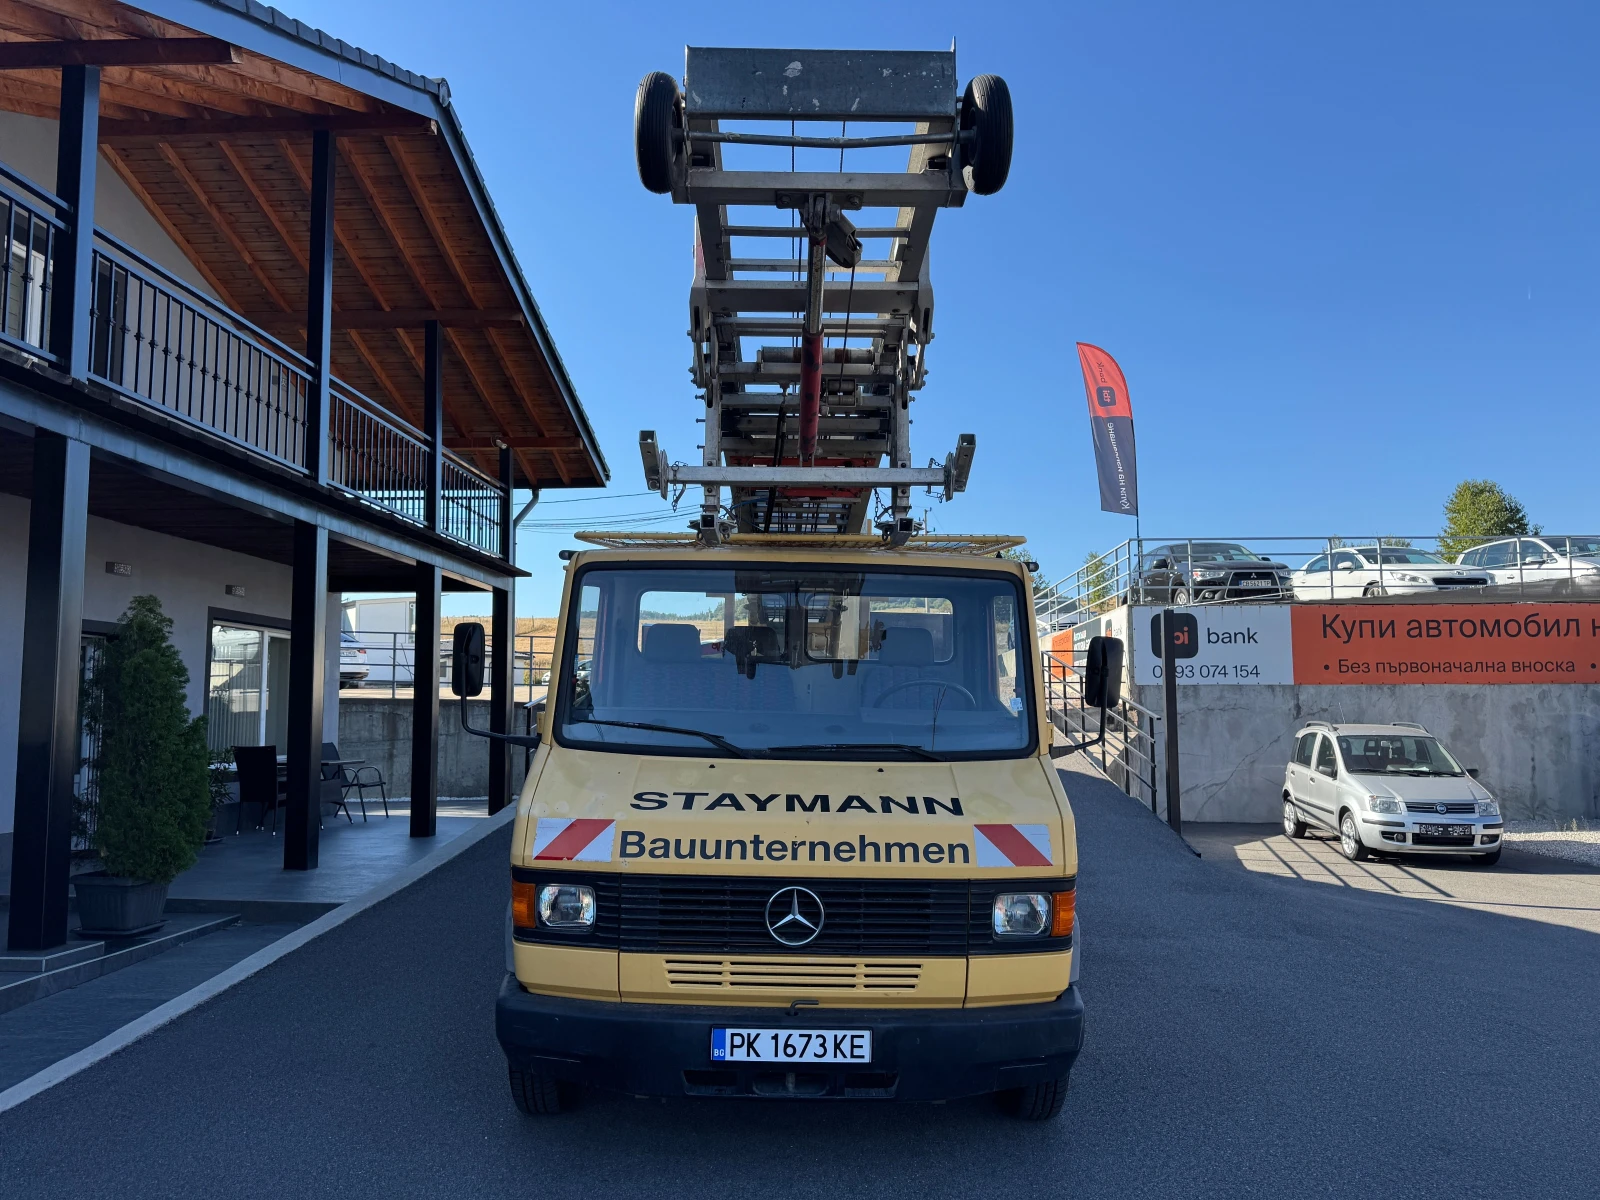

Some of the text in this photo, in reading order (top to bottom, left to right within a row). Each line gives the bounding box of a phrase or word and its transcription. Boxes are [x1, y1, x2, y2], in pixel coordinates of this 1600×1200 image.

[1207, 627, 1259, 645] bank
[1322, 613, 1396, 644] Купи
[1406, 612, 1580, 638] автомобил
[1152, 664, 1260, 679] 093 074 154
[1338, 659, 1575, 676] Без първоначална вноска
[630, 791, 965, 816] STAYMANN
[619, 830, 970, 864] Bauunternehmen
[714, 1049, 724, 1057] BG
